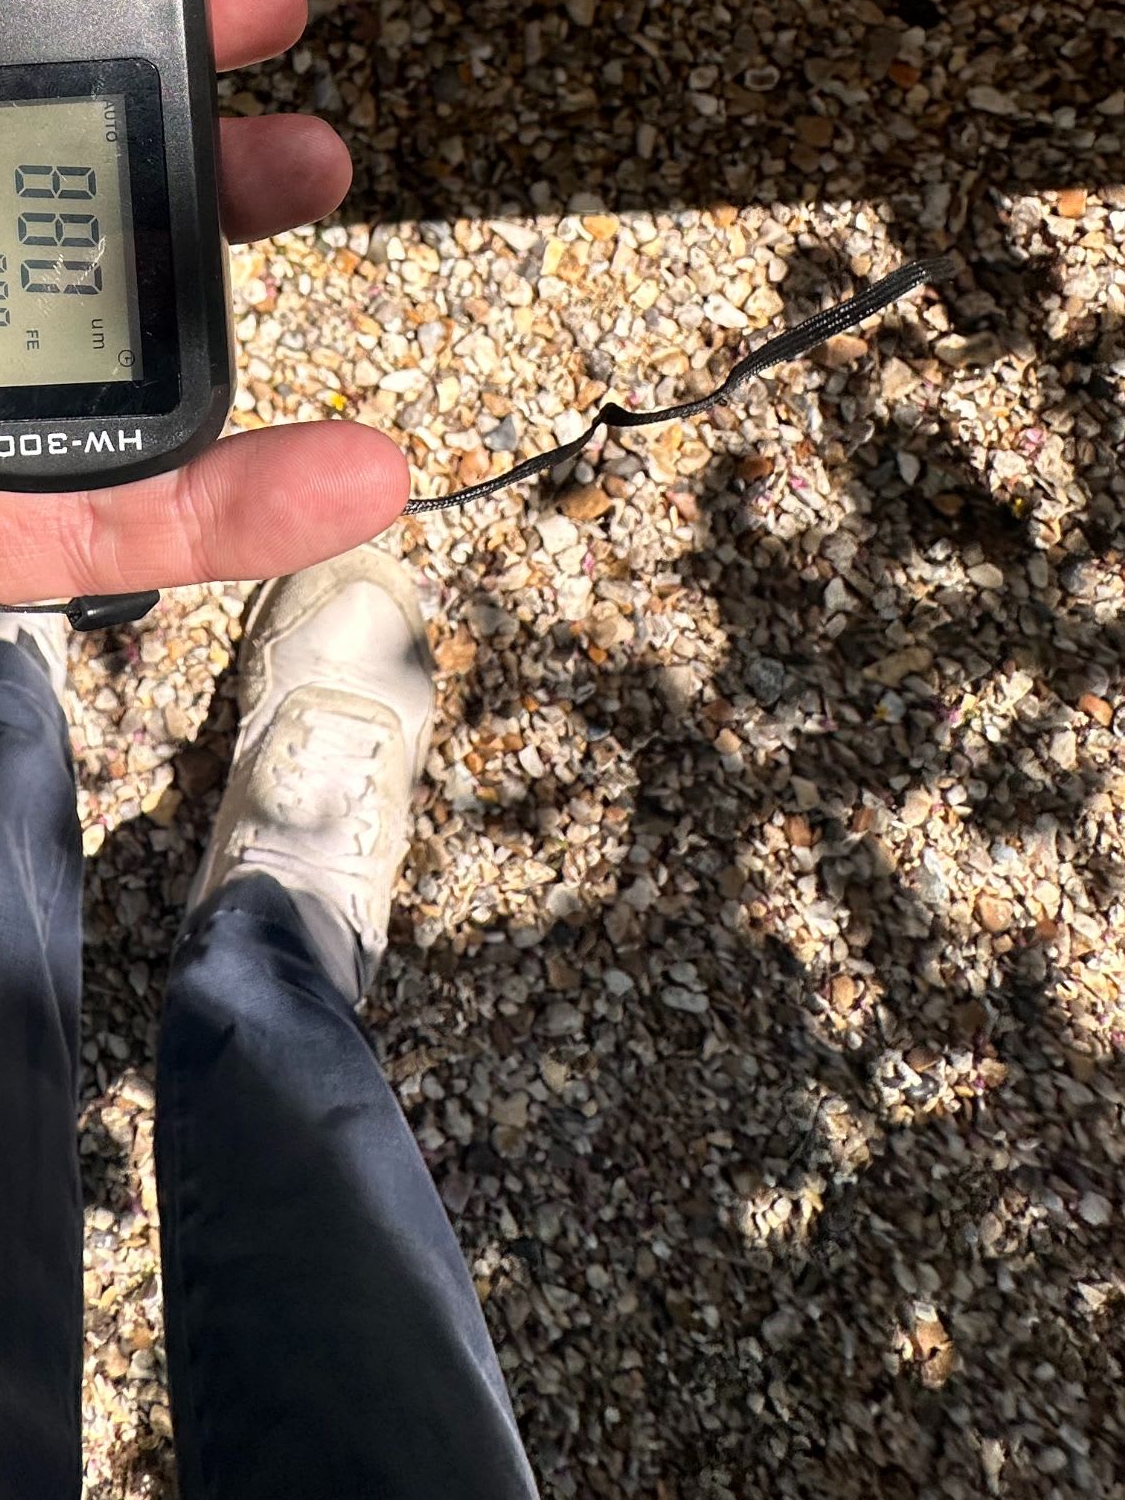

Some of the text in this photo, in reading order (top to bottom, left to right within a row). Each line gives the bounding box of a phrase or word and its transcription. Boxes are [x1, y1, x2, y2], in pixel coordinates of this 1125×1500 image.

[103, 100, 119, 143] AUTO
[26, 329, 40, 351] FE
[91, 317, 106, 351] um
